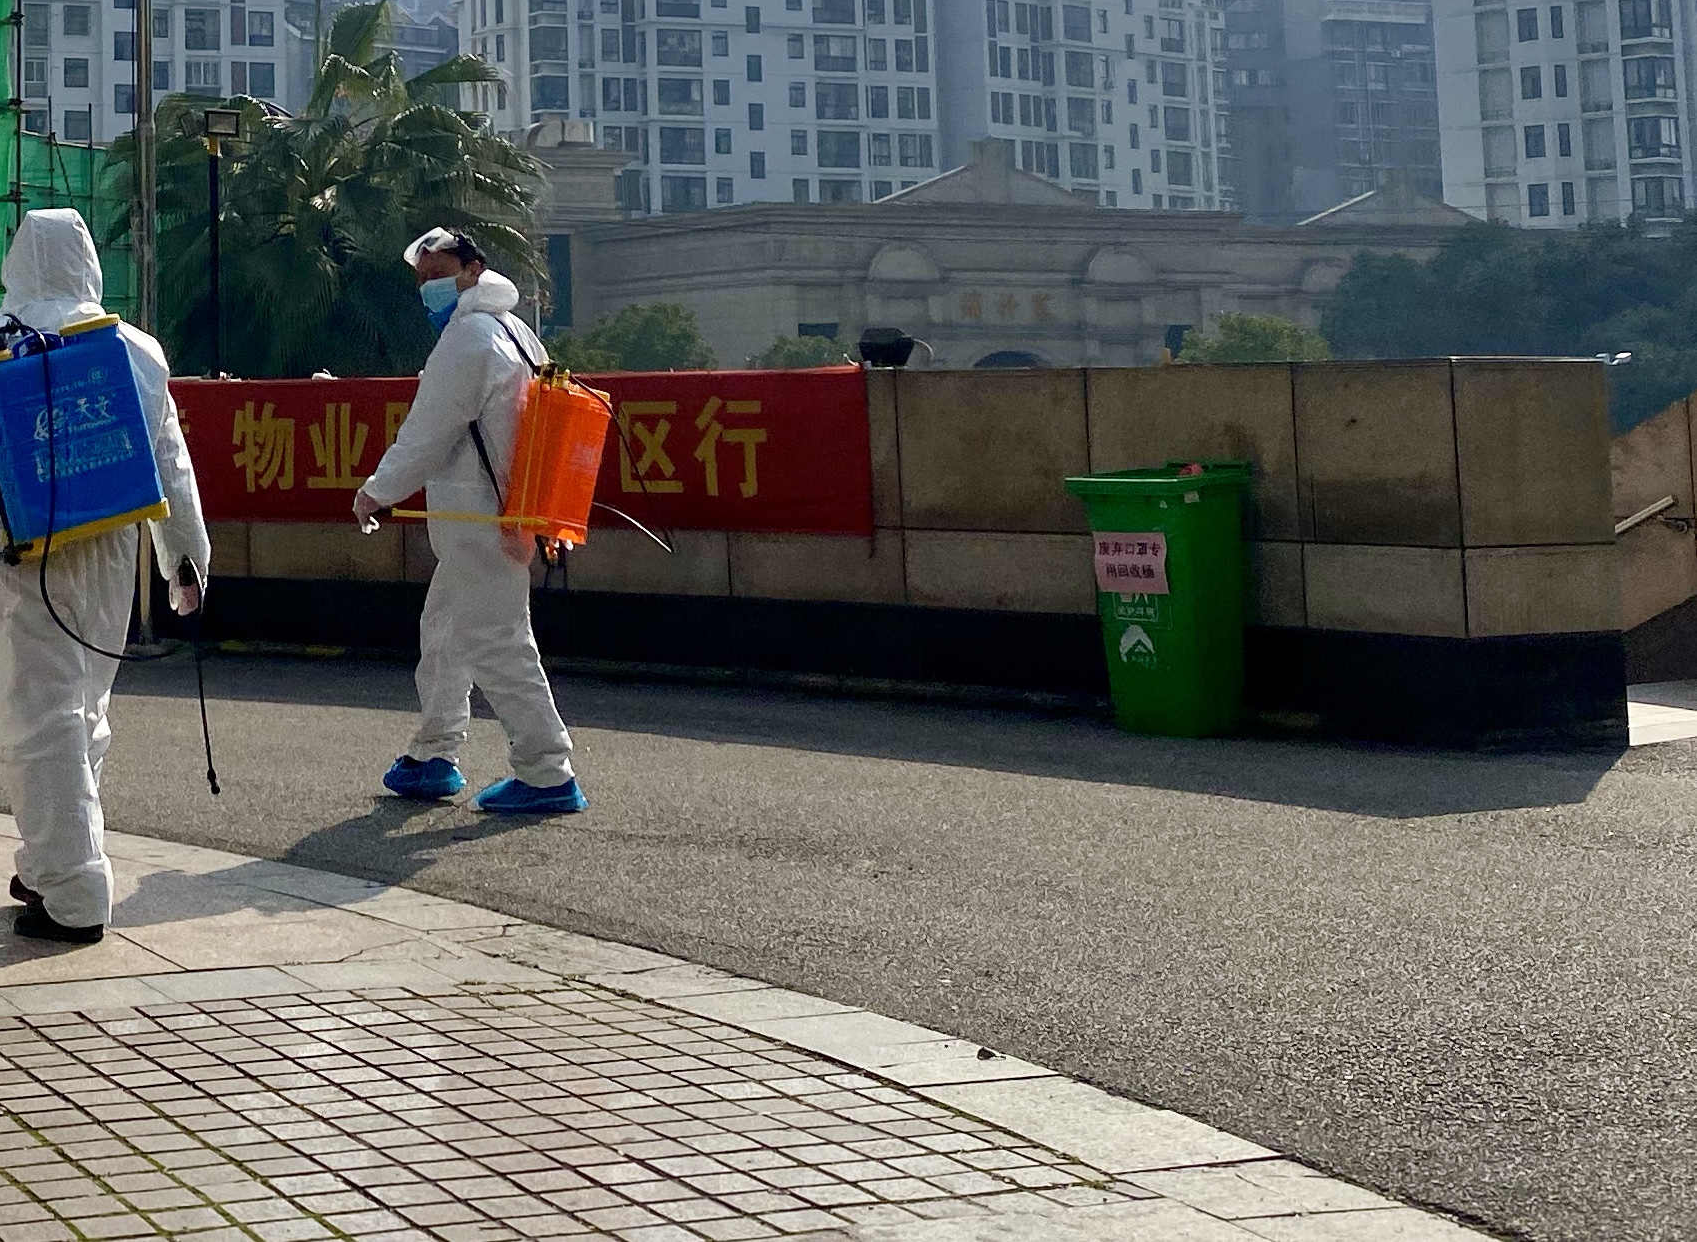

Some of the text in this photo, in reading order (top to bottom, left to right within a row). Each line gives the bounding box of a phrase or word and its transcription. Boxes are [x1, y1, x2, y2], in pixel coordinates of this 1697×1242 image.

[233, 396, 767, 498] 物业区行
[1099, 541, 1161, 557] 废弃口罩专
[1106, 564, 1154, 579] 用回收桶
